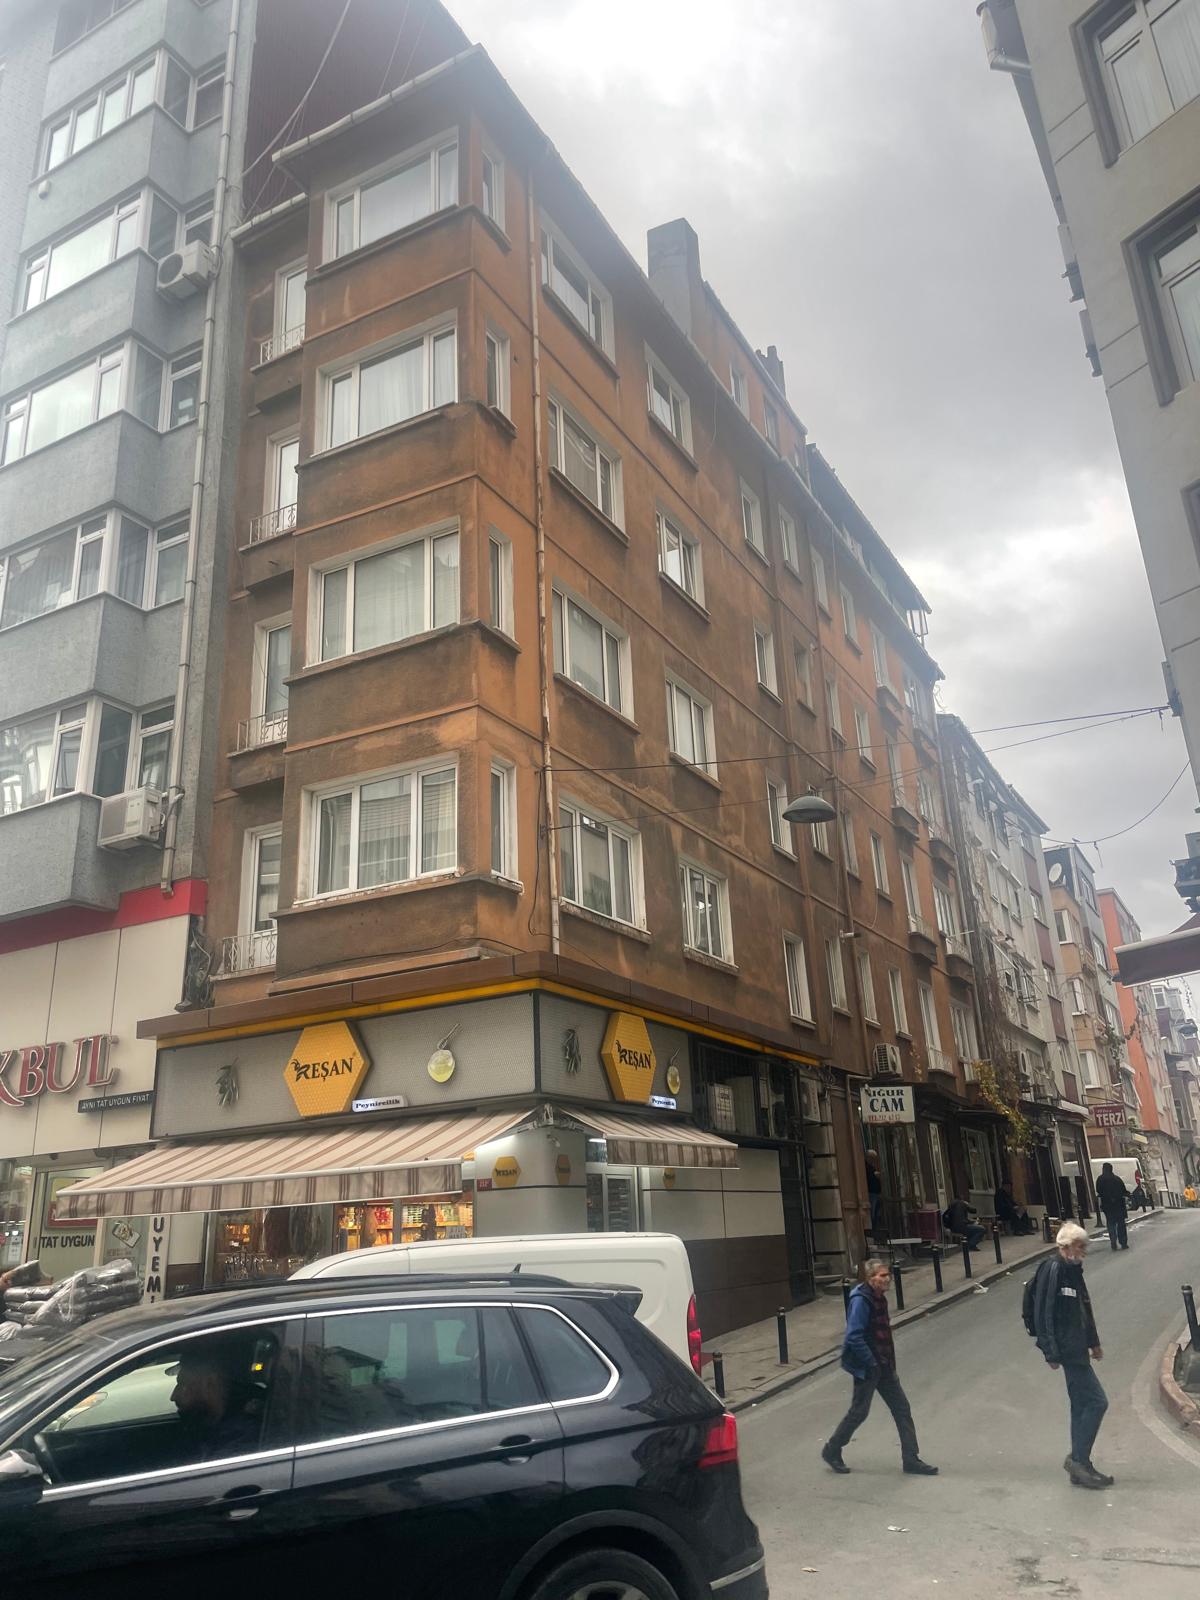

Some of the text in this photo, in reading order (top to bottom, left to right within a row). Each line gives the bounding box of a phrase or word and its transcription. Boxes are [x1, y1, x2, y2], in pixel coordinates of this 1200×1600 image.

[291, 1058, 354, 1082] REŞAN
[870, 1097, 904, 1112] CAM
[41, 1236, 59, 1249] TAT
[60, 1235, 96, 1248] UYGUN
